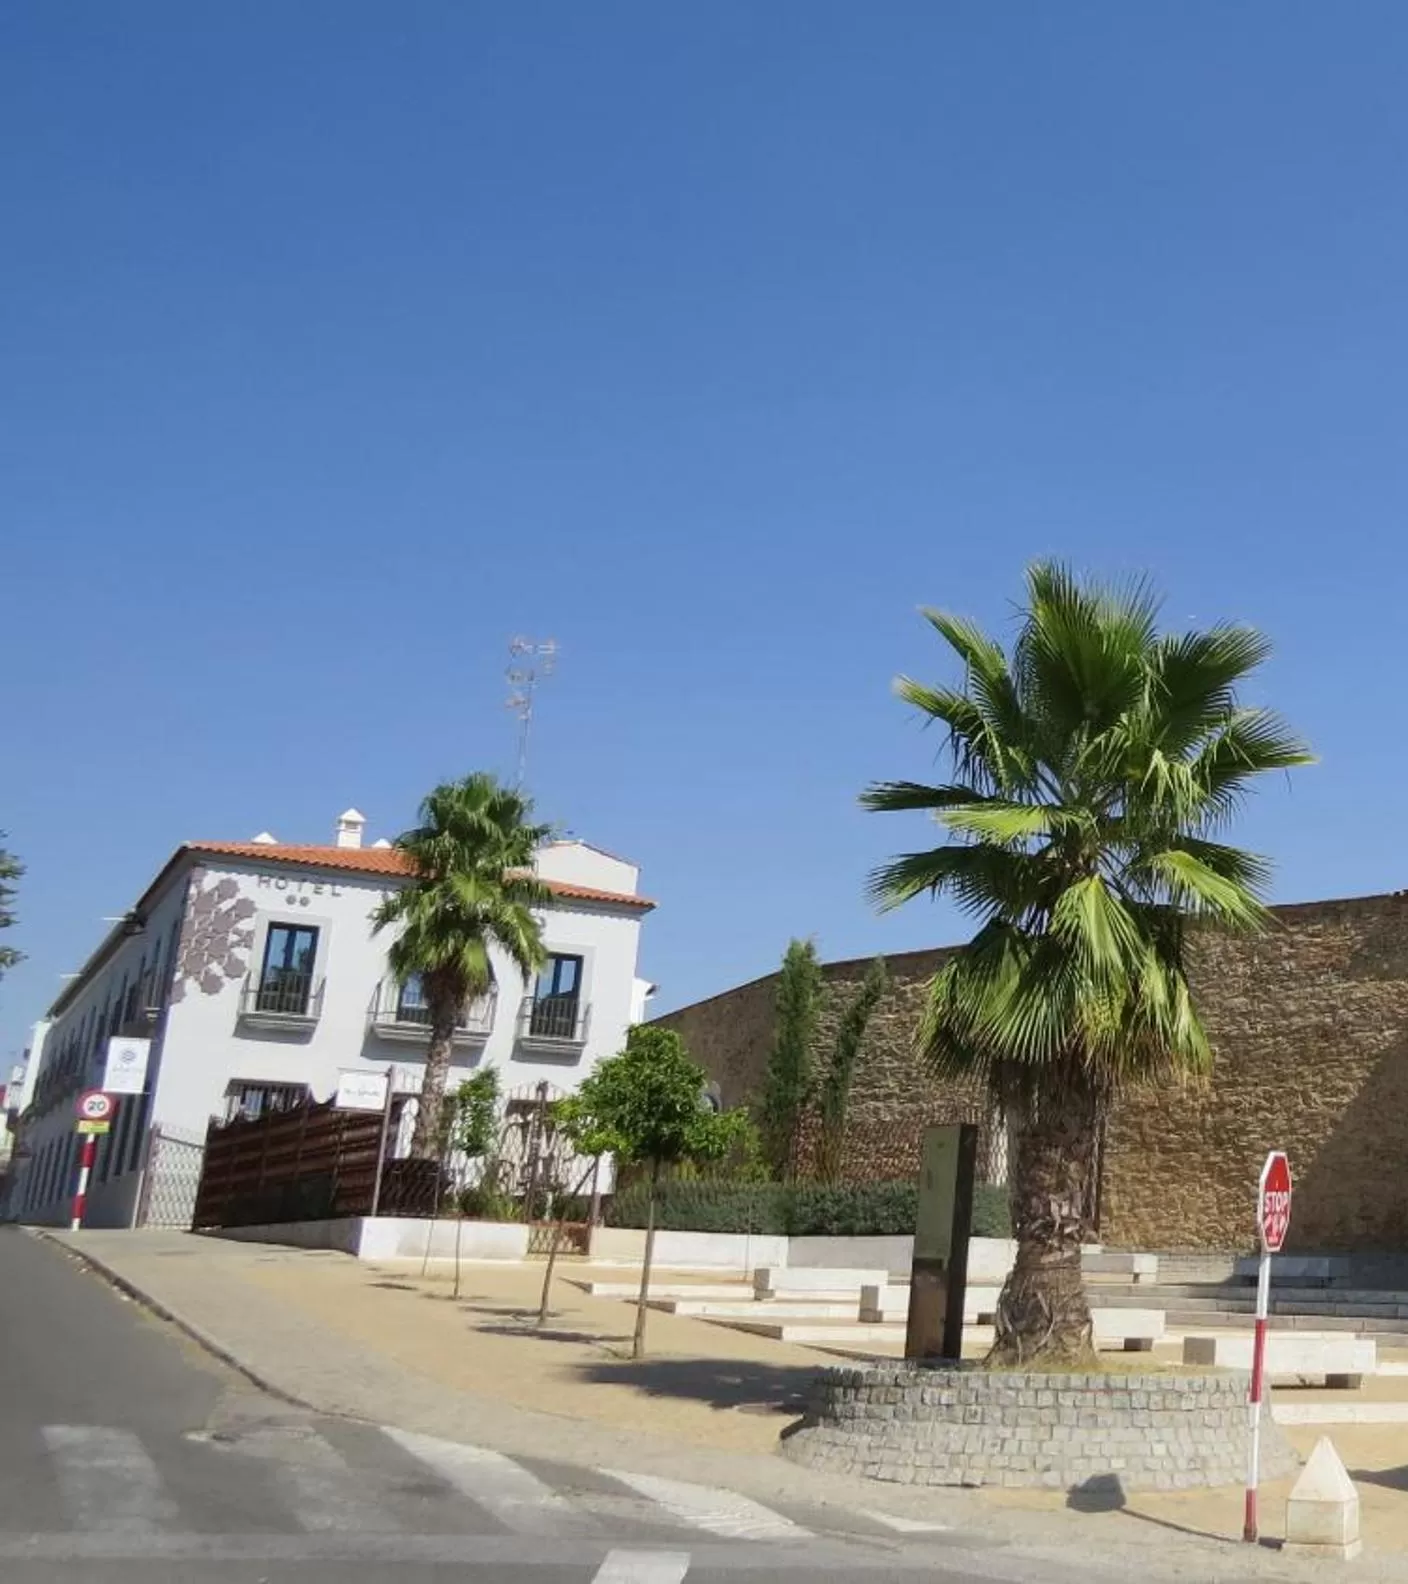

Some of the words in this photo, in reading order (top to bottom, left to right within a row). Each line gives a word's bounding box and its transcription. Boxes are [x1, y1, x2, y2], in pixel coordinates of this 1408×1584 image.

[257, 875, 342, 898] HOTEL
[87, 1100, 106, 1112] 20
[1265, 1191, 1288, 1212] STOP
